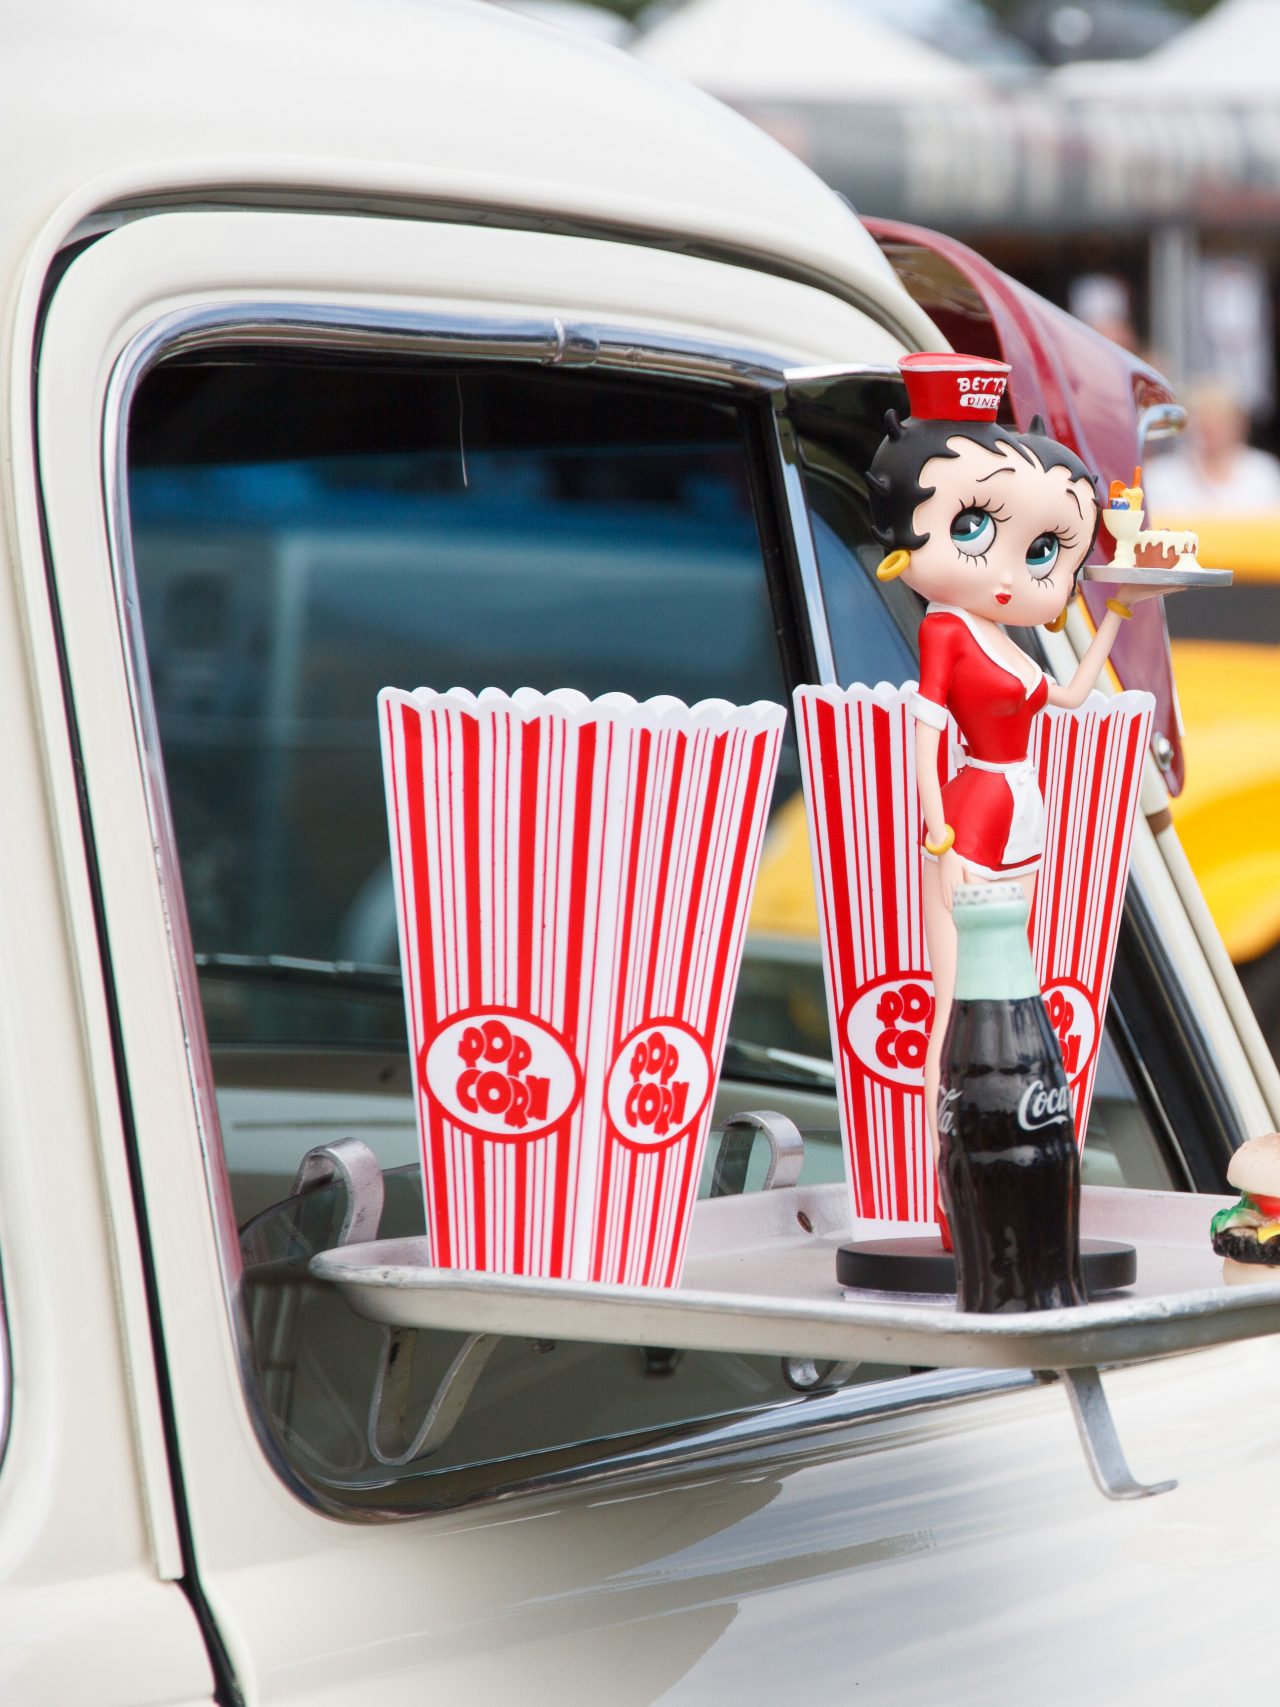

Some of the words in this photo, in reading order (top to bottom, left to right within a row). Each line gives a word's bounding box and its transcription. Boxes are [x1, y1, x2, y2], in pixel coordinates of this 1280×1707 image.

[458, 1020, 532, 1077] POP
[630, 1032, 679, 1085] POP
[875, 1028, 930, 1078] CO
[456, 1068, 550, 1129] CORN
[625, 1082, 689, 1136] CORN
